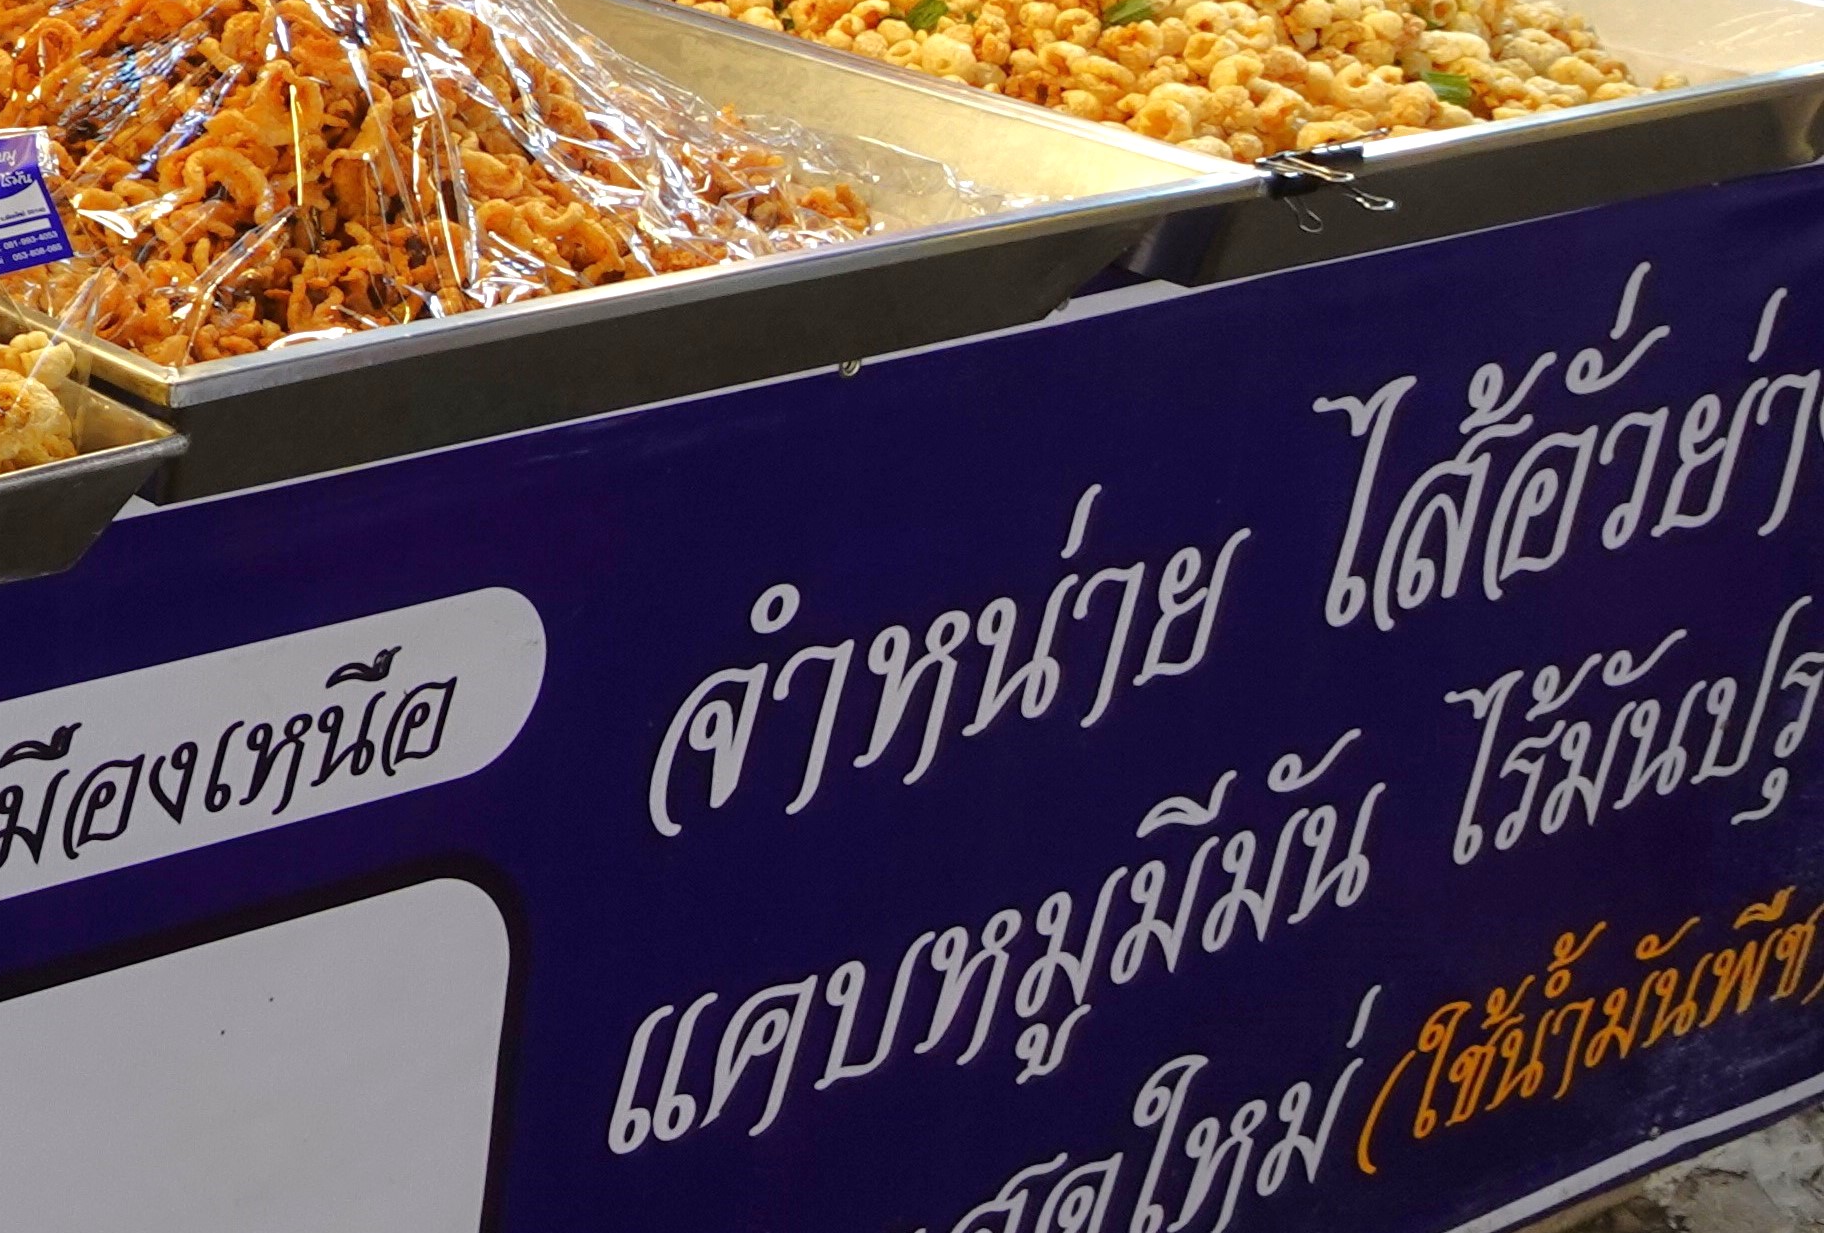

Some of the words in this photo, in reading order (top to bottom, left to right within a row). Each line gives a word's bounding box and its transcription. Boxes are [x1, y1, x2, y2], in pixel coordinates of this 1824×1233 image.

[648, 485, 1253, 837] จำหน่าย
[1312, 262, 1824, 632] ไส้อั่วย่า
[608, 729, 1386, 1156] แคบหมูมีมัน
